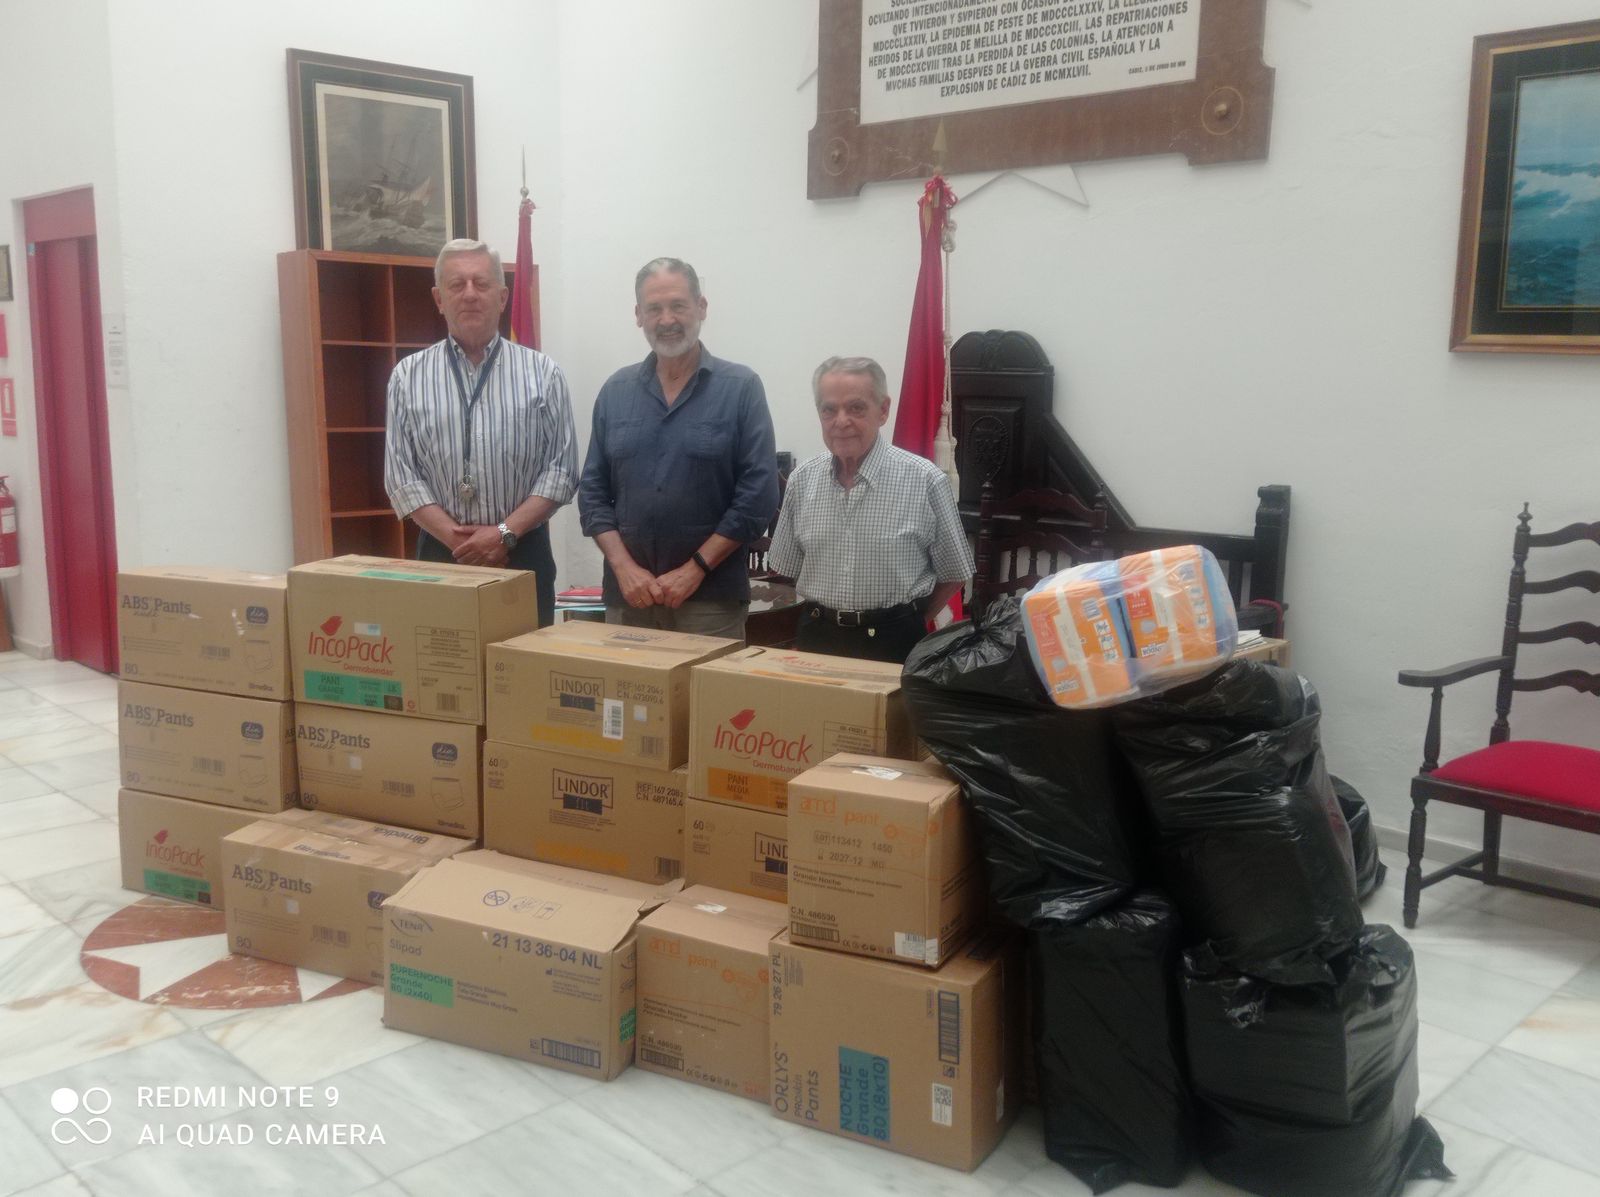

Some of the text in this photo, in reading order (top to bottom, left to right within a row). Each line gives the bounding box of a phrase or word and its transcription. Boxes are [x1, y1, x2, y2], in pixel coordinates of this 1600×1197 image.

[893, 22, 907, 36] QVE
[910, 15, 947, 32] TVVIERON
[950, 14, 955, 25] Y
[957, 6, 998, 23] SVPIERON
[1001, 1, 1018, 15] CON
[912, 0, 997, 17] INTENCIONADAME
[930, 31, 940, 43] LA
[943, 24, 981, 40] EPIDEMIA
[984, 21, 995, 32] DE
[998, 16, 1024, 31] PESTE
[1027, 13, 1038, 24] DE
[1109, 0, 1120, 10] LA
[869, 52, 900, 67] HERIDOS
[903, 49, 912, 61] DE
[915, 47, 924, 59] LA
[927, 41, 957, 57] GVERRA
[961, 39, 971, 51] DE
[974, 33, 1008, 48] MELILLA
[1011, 31, 1022, 43] DE
[1086, 15, 1102, 30] LAS
[1106, 1, 1188, 26] REPATRIACIONES
[877, 67, 887, 79] DE
[942, 56, 962, 69] TRAS
[965, 53, 975, 64] LA
[978, 46, 1013, 62] PERDIDA
[1017, 44, 1027, 56] DE
[1031, 40, 1047, 54] LAS
[1050, 33, 1098, 51] COLONIAS,
[1101, 30, 1112, 43] LA
[1116, 21, 1163, 40] ATENCION
[1167, 19, 1174, 32] A
[886, 37, 1161, 92] MVCHAS FAMILIAS DESPVES DE LA GVERRA CIVIL ESPAÑOLA Y LA
[940, 81, 984, 97] EXPLOSION
[987, 78, 998, 90] DE
[1001, 74, 1027, 89] CADIZ
[1030, 71, 1041, 84] DE
[121, 595, 149, 610] ABS
[154, 598, 192, 615] Pants
[308, 632, 394, 664] IncoPack
[554, 678, 601, 696] LINDOR
[124, 704, 151, 720] ABS
[156, 709, 195, 728] Pants
[297, 724, 325, 742] ABS
[330, 730, 371, 749] Pants
[713, 724, 815, 764] IncoPack
[752, 760, 803, 775] Dermoband
[557, 776, 608, 799] LINDOR
[693, 819, 704, 831] 60
[146, 840, 205, 869] IncoPack
[760, 840, 788, 859] LIND
[232, 864, 263, 884] ABS
[269, 871, 312, 895] Pants
[492, 932, 603, 970] 21 13 36-04 NL
[772, 952, 781, 967] PL
[390, 963, 454, 987] SUPERNOCHE
[773, 969, 783, 984] 27
[773, 986, 783, 1001] 26
[774, 1050, 788, 1113] ORLYS
[805, 1069, 820, 1122] Pants
[839, 1062, 853, 1131] NOCHE
[855, 1067, 870, 1136] Grande
[872, 1055, 889, 1139] 80 (8x10)
